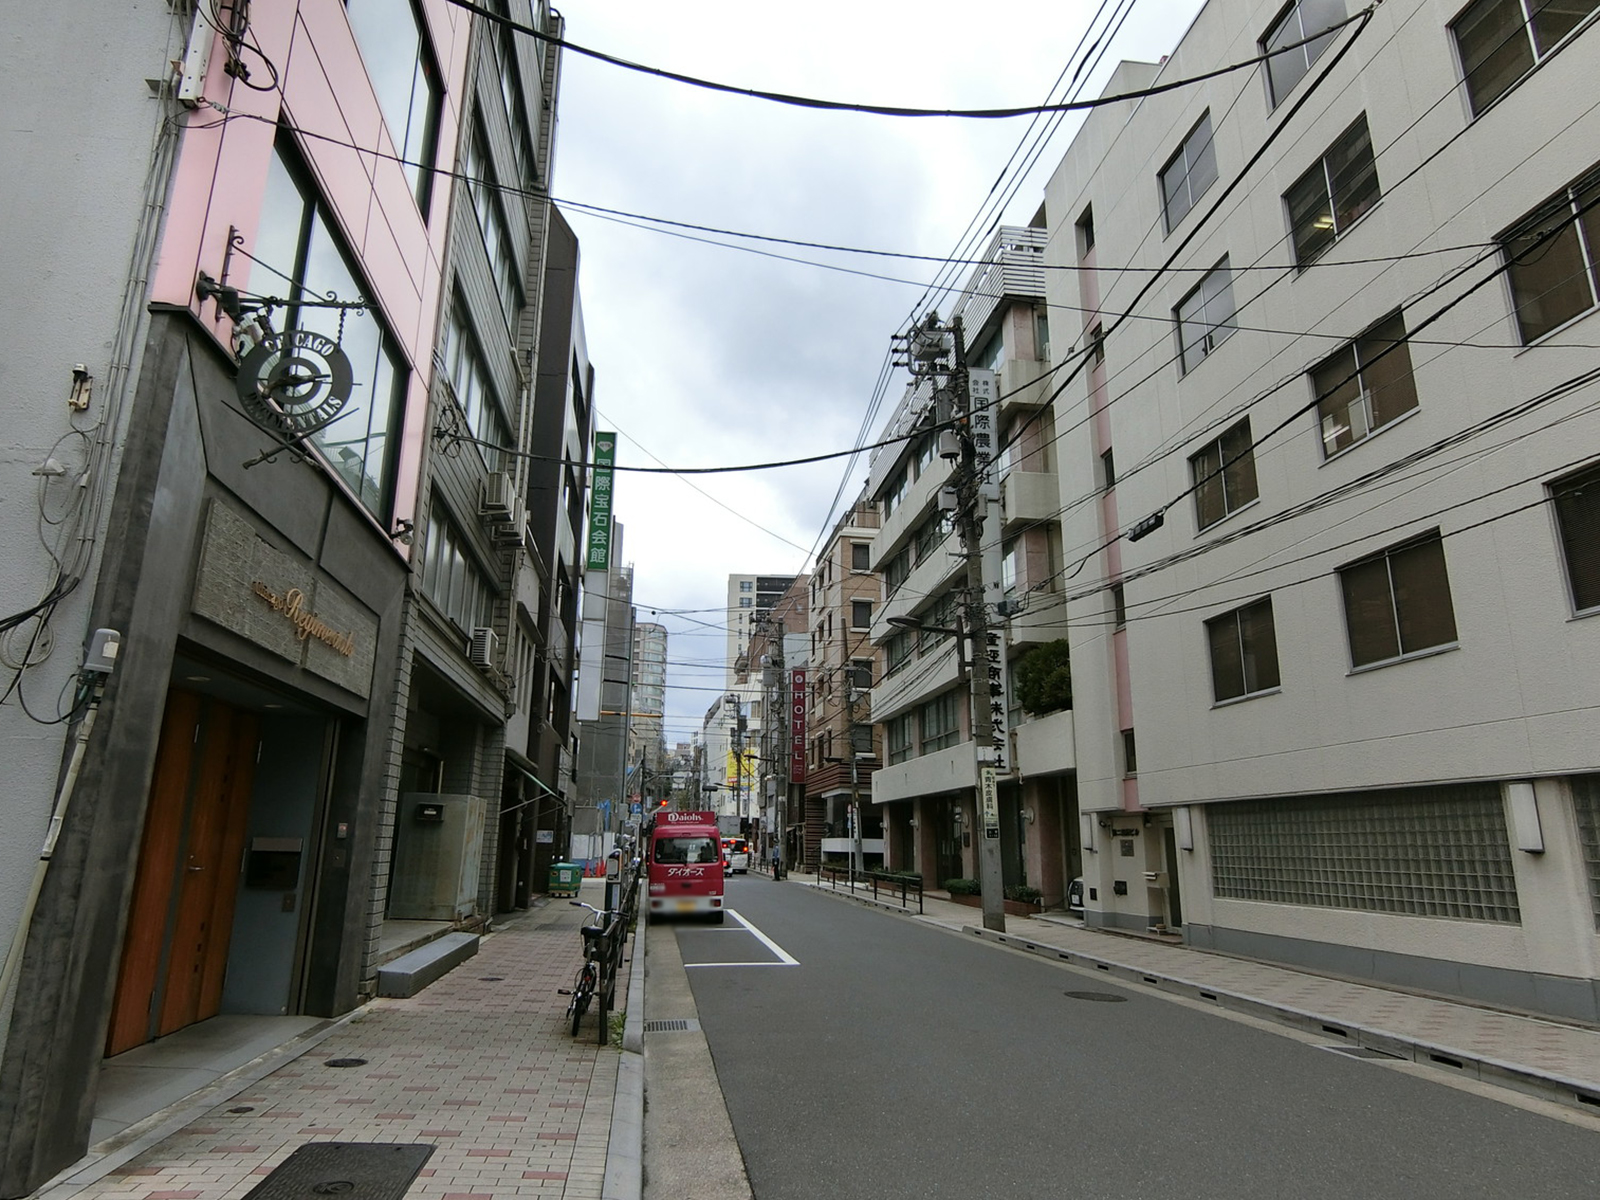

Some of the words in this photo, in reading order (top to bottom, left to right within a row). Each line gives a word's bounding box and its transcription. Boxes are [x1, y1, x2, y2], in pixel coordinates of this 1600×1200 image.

[263, 332, 335, 357] CHICAGO
[590, 458, 611, 563] 国際宝石会館
[794, 691, 804, 760] HOTEL
[667, 812, 702, 822] Daiohs
